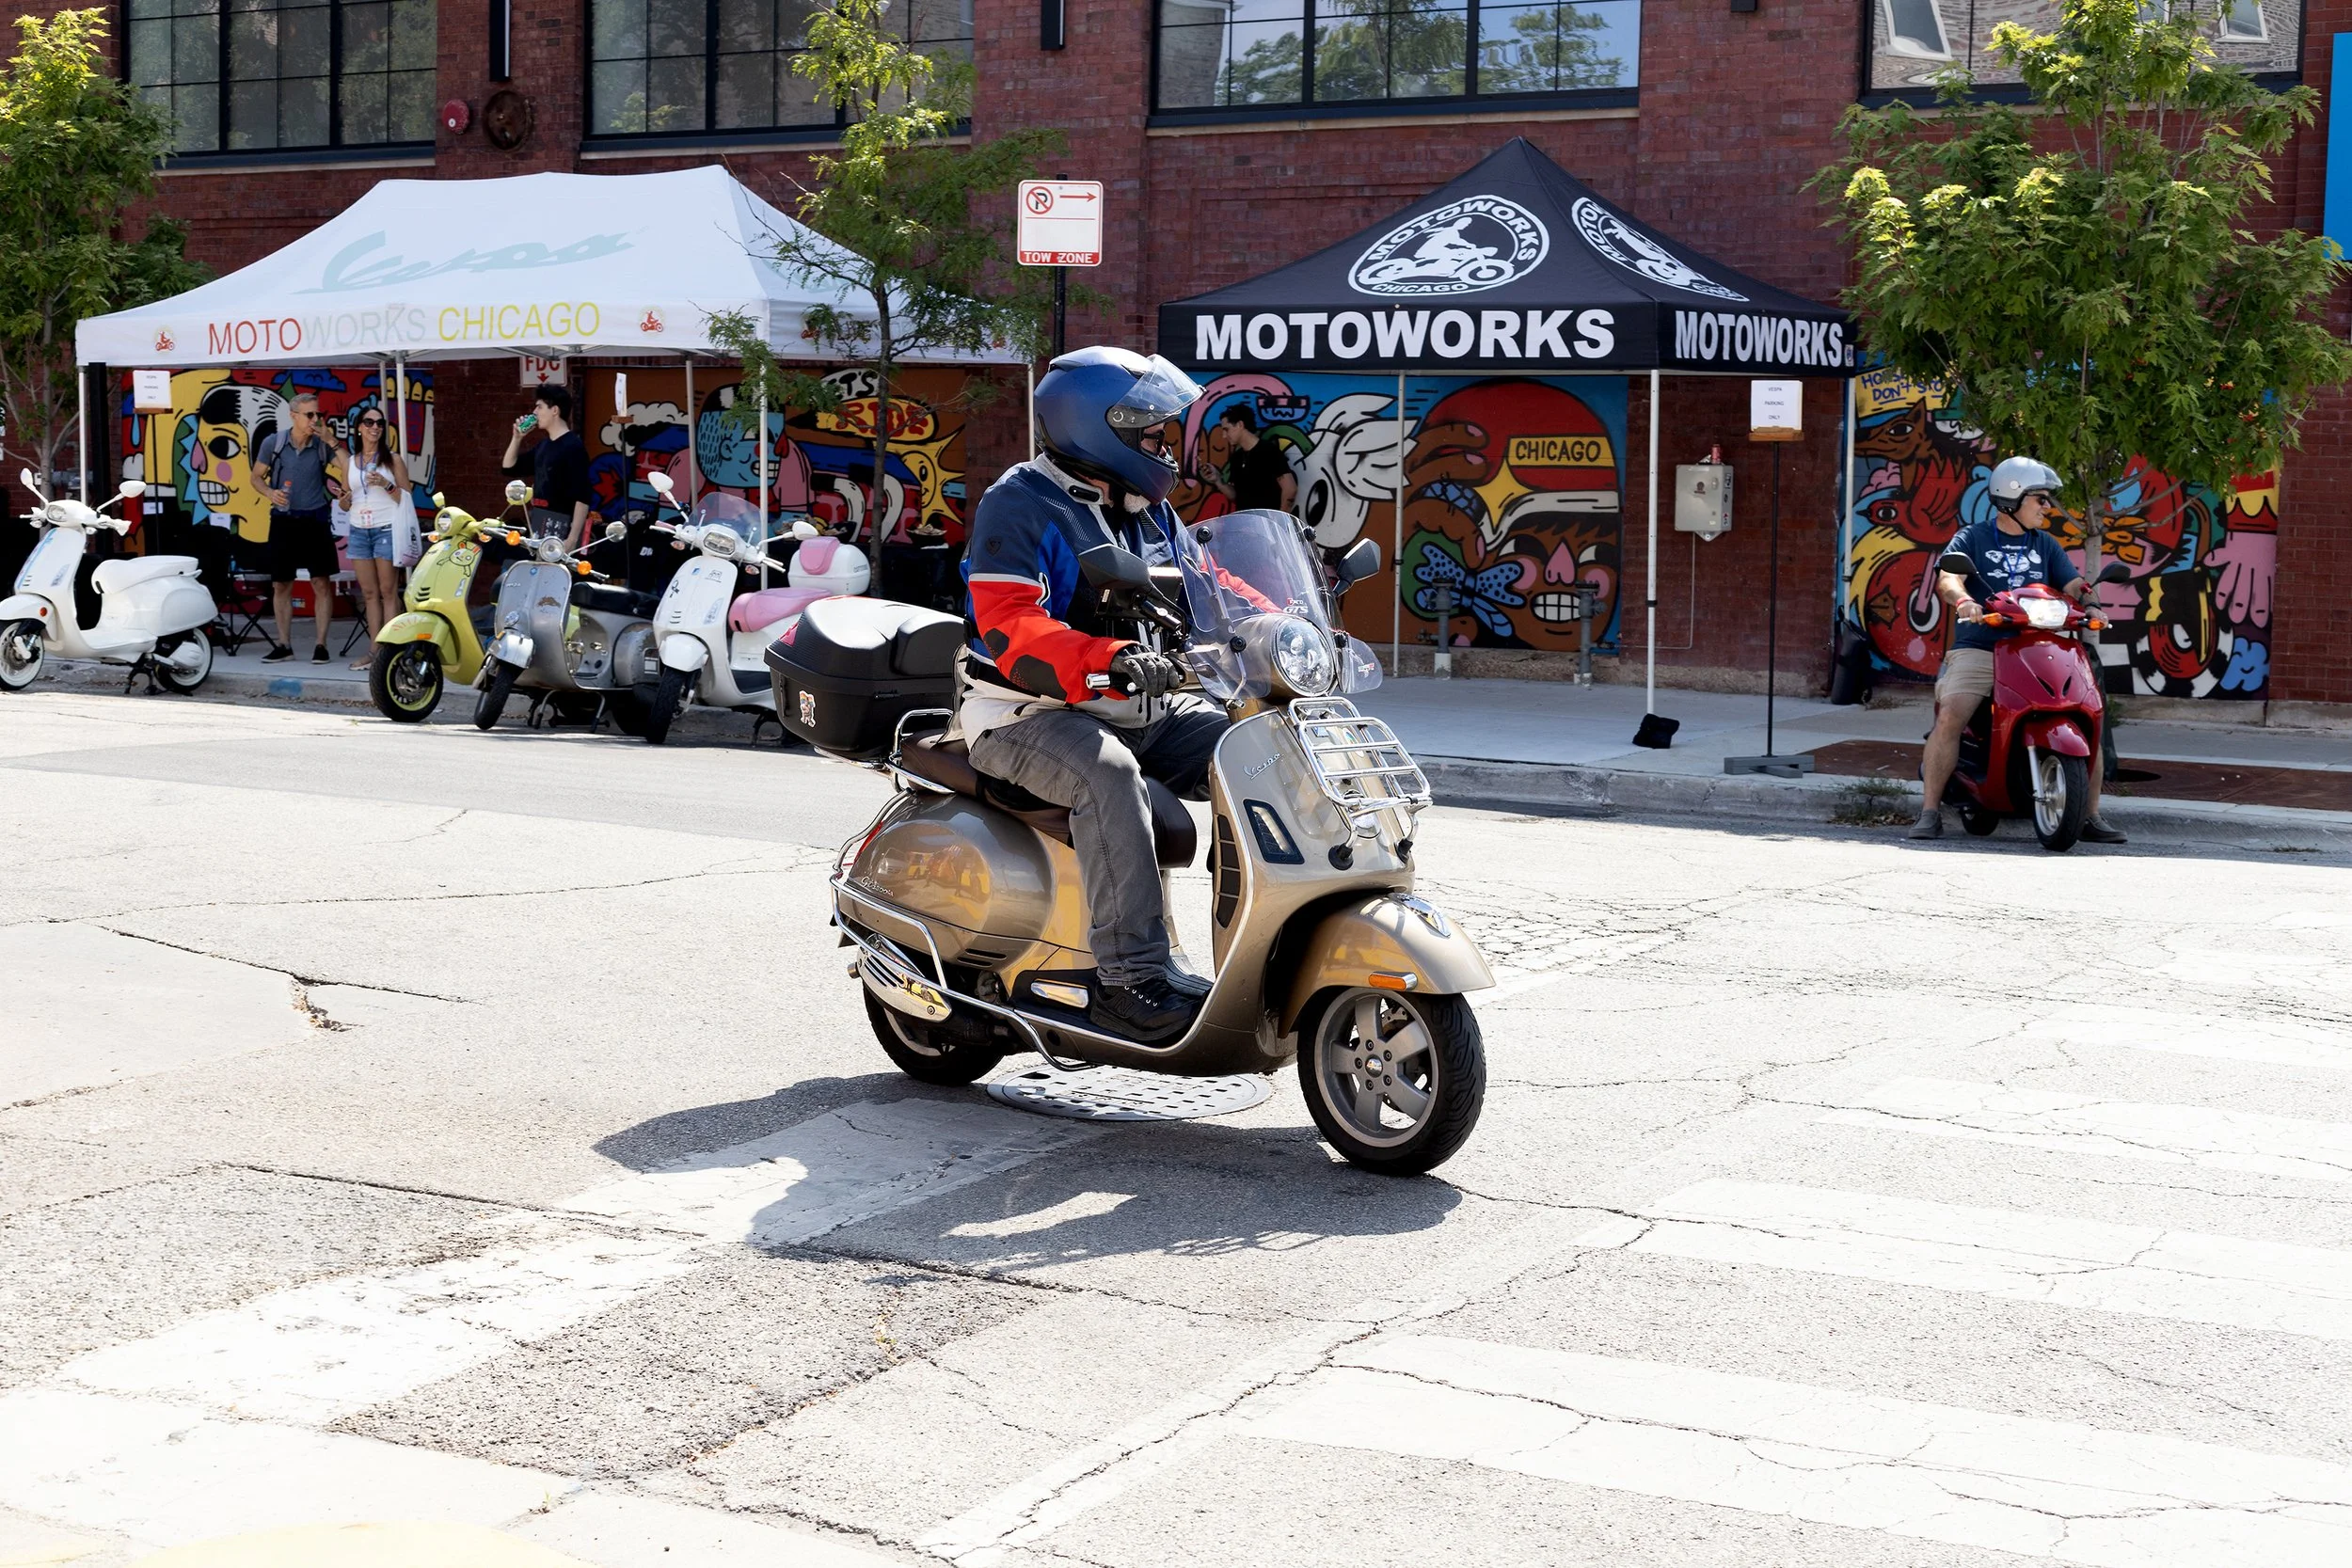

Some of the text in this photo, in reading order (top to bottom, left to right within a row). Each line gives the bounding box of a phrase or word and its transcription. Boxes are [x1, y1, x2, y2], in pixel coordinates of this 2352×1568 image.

[1367, 200, 1540, 261] MOTOWORKS
[1024, 251, 1093, 263] TOW ZONE
[1371, 282, 1470, 293] CHICAGO
[207, 301, 601, 356] MOTOWORKS CHICAGO
[1196, 309, 1615, 360] MOTOWORKS
[1675, 309, 1844, 368] MOTOWORKS
[1516, 440, 1601, 463] CHICAGO
[1282, 606, 1309, 614] GTS
